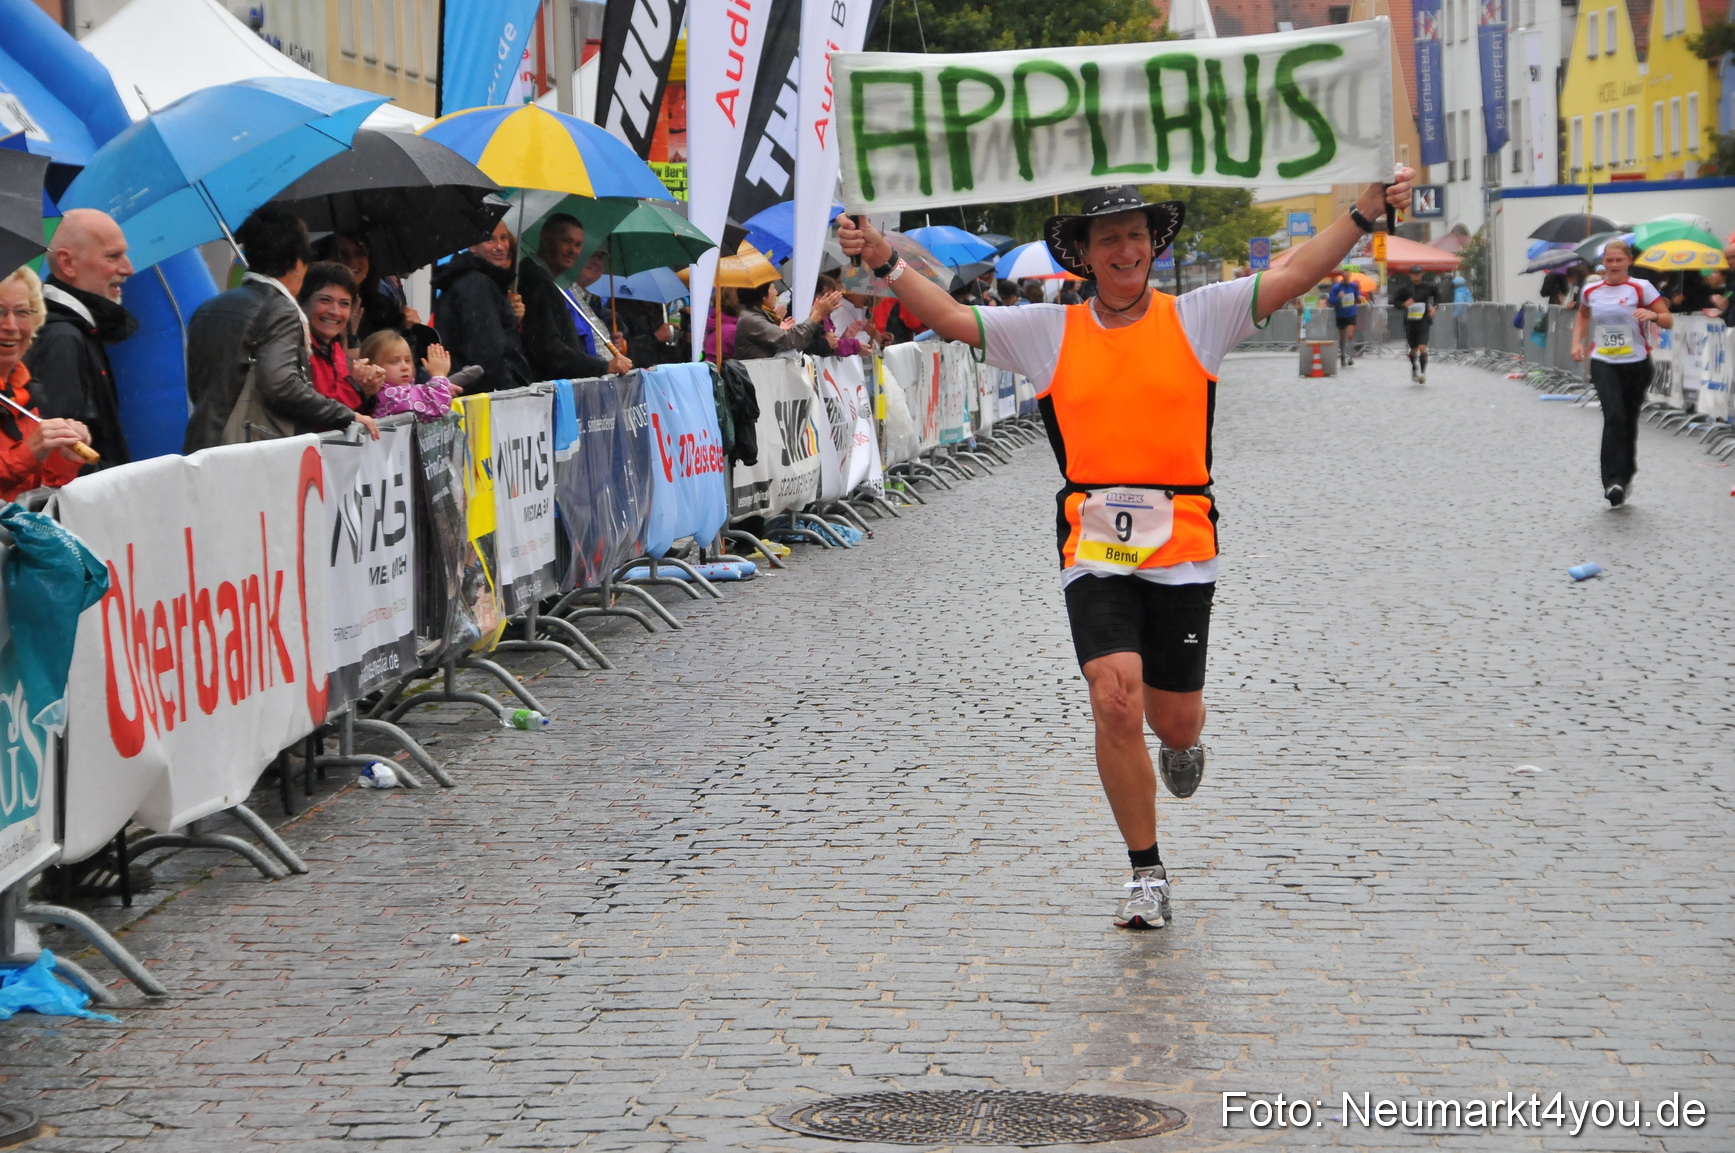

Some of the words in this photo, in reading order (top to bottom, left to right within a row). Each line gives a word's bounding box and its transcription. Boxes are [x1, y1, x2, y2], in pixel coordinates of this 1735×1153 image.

[1492, 31, 1505, 99] RUPPERT
[849, 42, 1344, 203] APPLAUS
[1156, 260, 1172, 268] TAXI
[1252, 259, 1269, 268] TAXI
[1106, 493, 1144, 503] BOCK
[1114, 511, 1133, 542] 9
[1105, 547, 1138, 564] Bernd
[100, 511, 294, 758] Oberbank
